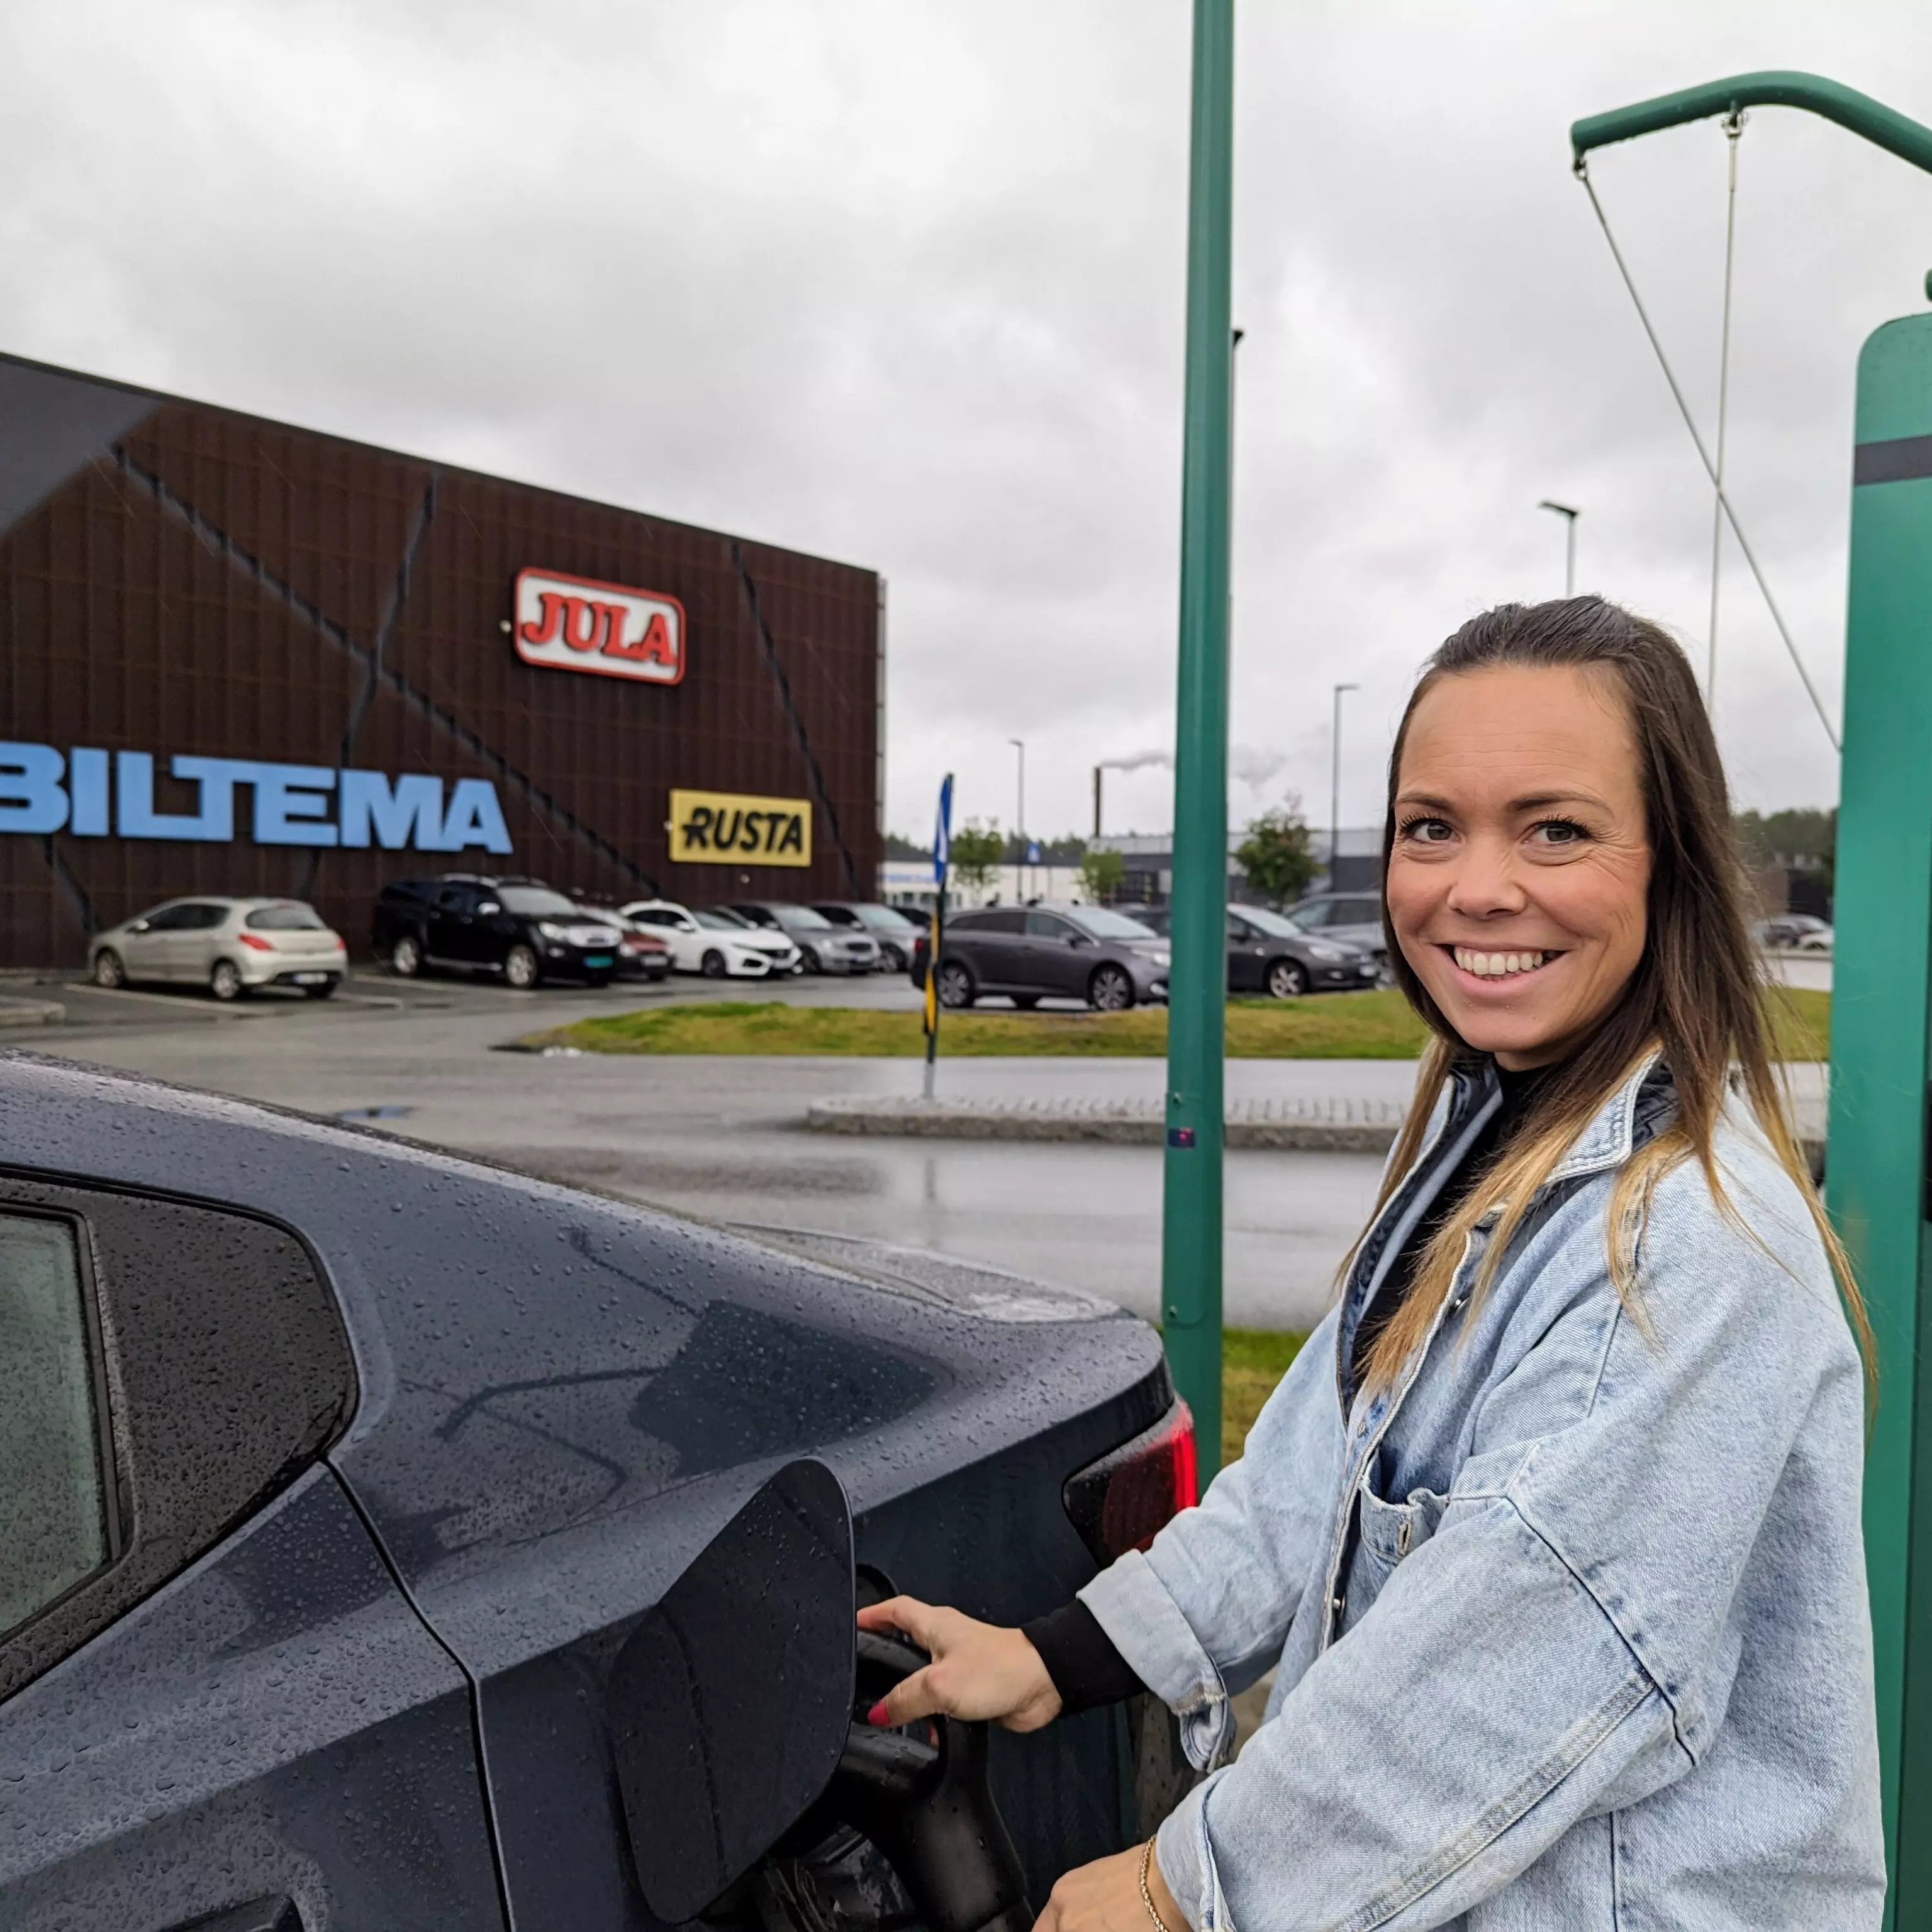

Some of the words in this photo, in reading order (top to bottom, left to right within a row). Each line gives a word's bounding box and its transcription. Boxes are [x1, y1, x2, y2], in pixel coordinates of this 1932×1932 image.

[522, 593, 675, 665] JULA
[0, 741, 513, 854] BILTEMA
[683, 807, 803, 854] RUSTA
